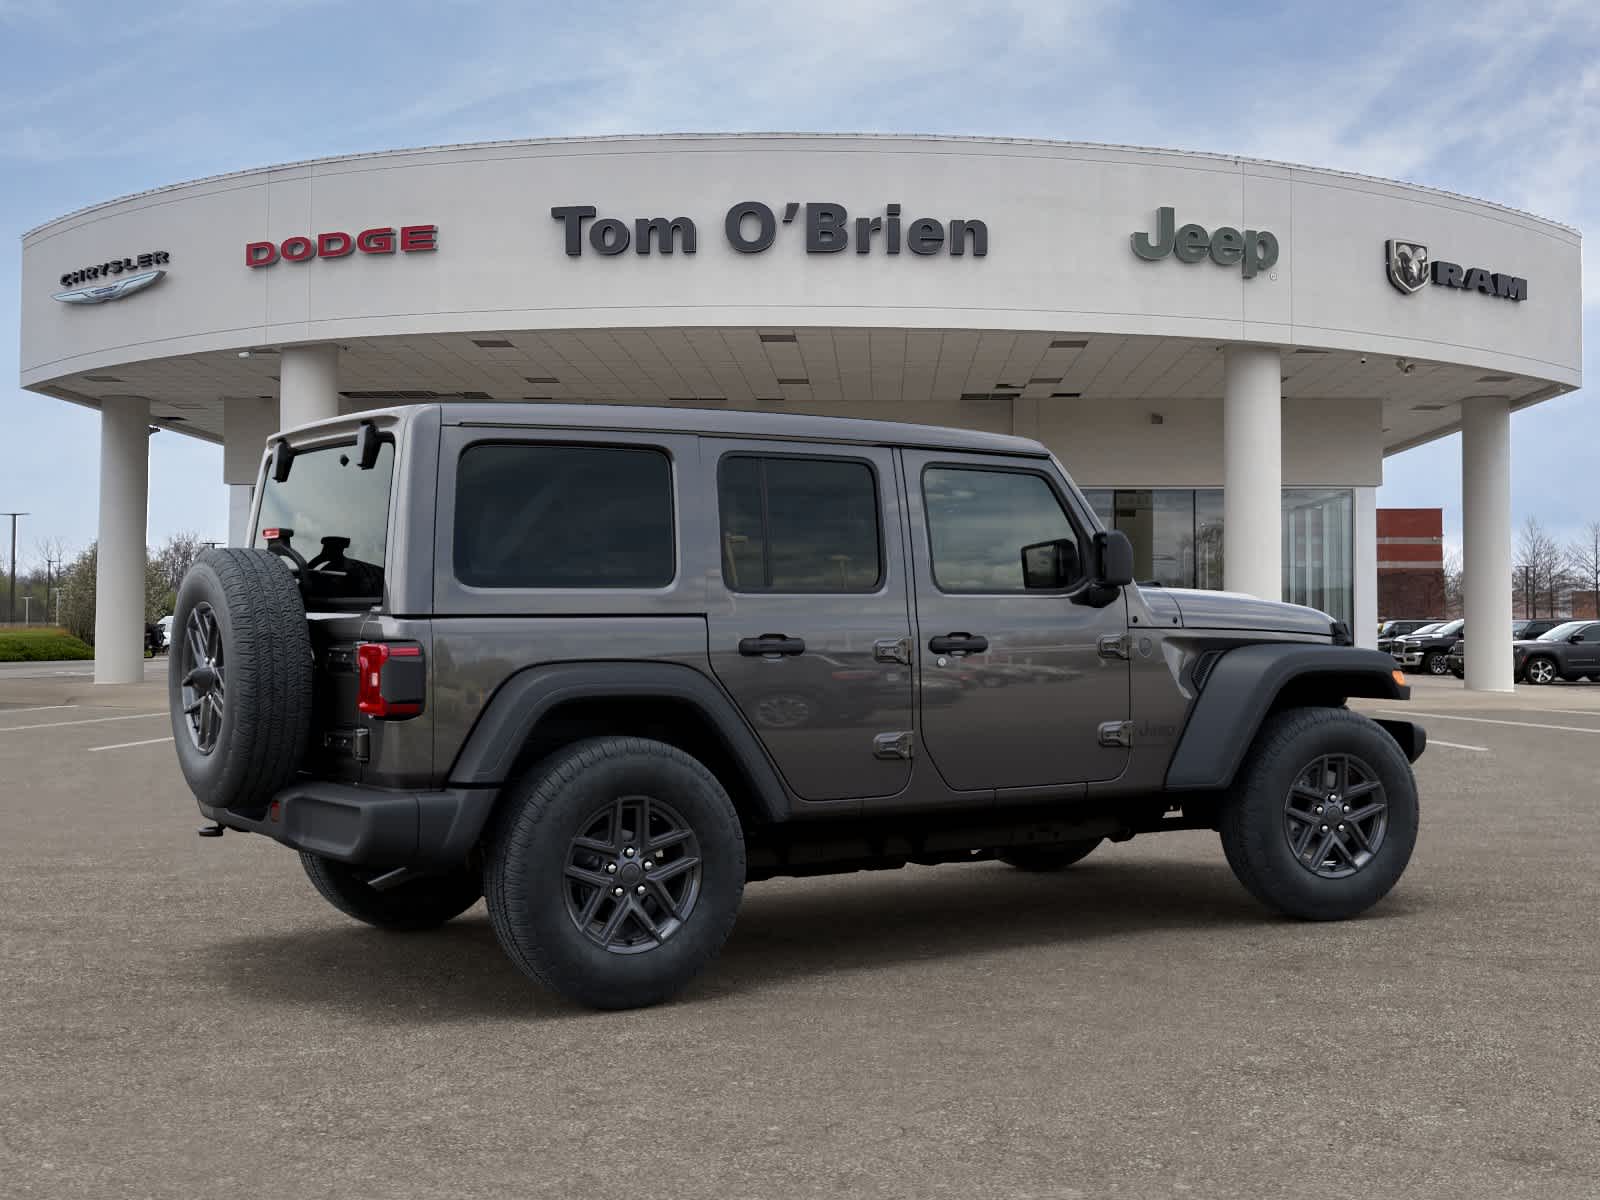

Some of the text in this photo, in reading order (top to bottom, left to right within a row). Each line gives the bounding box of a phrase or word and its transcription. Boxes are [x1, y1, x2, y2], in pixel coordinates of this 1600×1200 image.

[245, 225, 438, 268] DODGE
[551, 201, 988, 256] Tom O'Brien
[1131, 206, 1279, 279] Jeep
[60, 251, 169, 286] CHRYSLER
[1431, 261, 1527, 301] RAM
